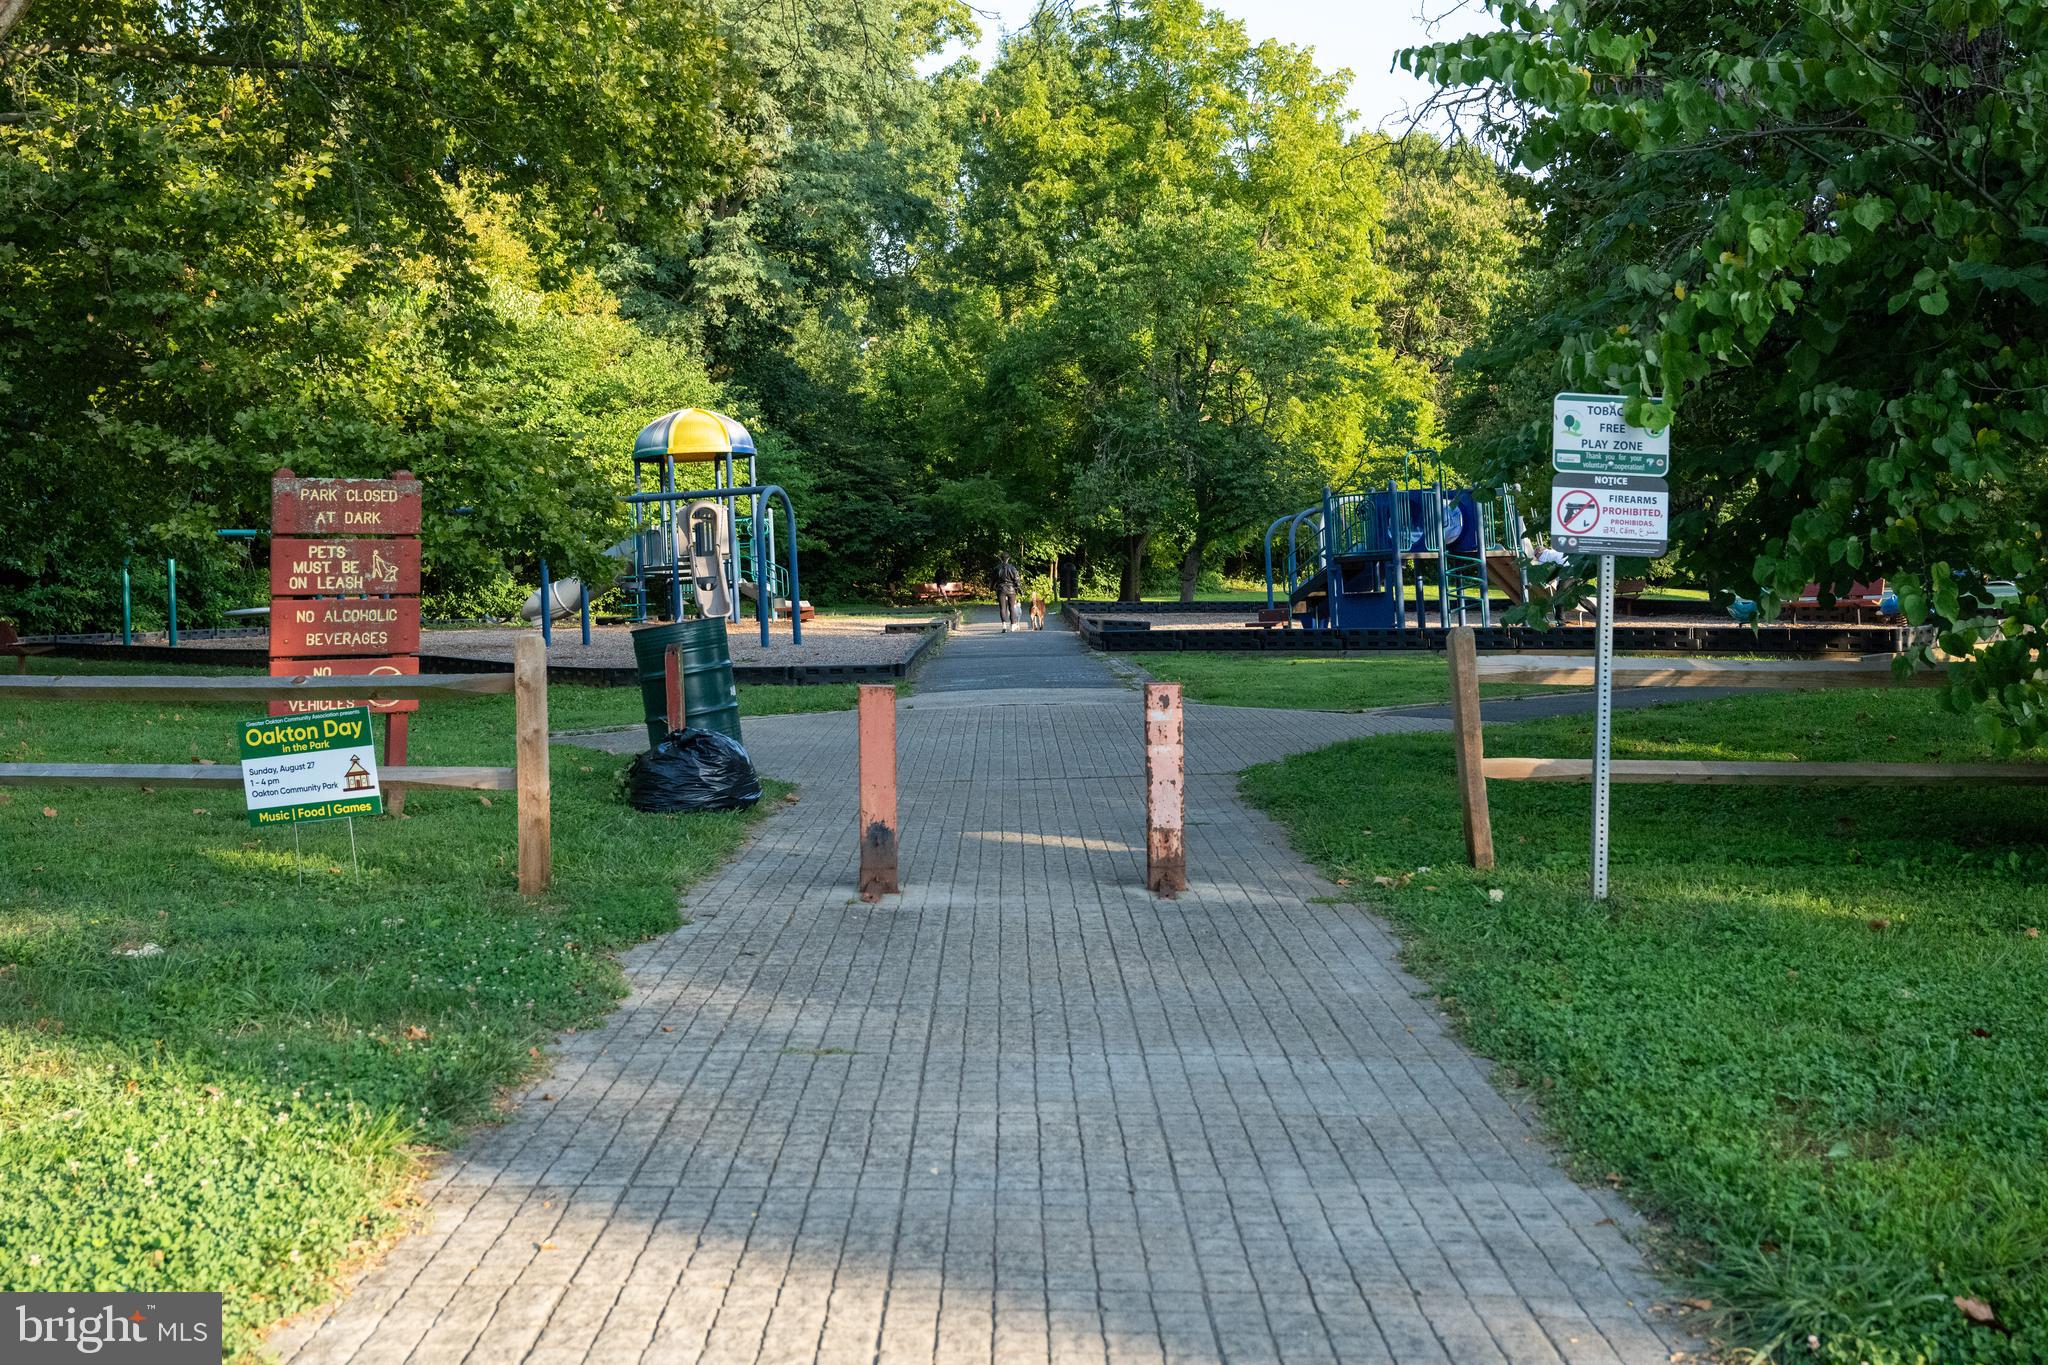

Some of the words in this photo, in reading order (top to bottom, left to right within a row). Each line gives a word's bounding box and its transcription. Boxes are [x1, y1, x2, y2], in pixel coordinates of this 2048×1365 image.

[1587, 405, 1624, 416] TOBAC
[1600, 423, 1625, 433] FREE
[1581, 439, 1608, 449] PLAY
[1613, 441, 1643, 450] ZONE
[1583, 462, 1608, 470] voluntary
[1595, 476, 1628, 485] NOTICE
[300, 489, 337, 501] PARK
[347, 490, 397, 502] CLOSED
[1609, 495, 1657, 504] FIREARMS
[316, 512, 336, 524] AT
[345, 512, 381, 524] DARK
[1603, 507, 1663, 518] PROHIBITED,
[309, 546, 346, 558] PETS
[294, 562, 332, 574] MUST
[342, 561, 359, 573] BE
[289, 577, 307, 589] ON
[318, 576, 363, 589] LEASH
[296, 611, 314, 623] NO
[324, 609, 397, 622] ALCOHOLIC
[306, 632, 387, 645] BEVERAGES
[313, 667, 332, 677] NO
[289, 700, 355, 711] VEHICLES
[246, 726, 318, 746] Oakton
[324, 720, 362, 738] Day
[292, 742, 307, 751] the
[310, 740, 330, 750] Park
[249, 766, 278, 776] Sunday,
[280, 763, 305, 773] August
[268, 778, 279, 786] pm
[252, 789, 279, 798] Oakton
[280, 784, 320, 795] Community
[259, 810, 290, 822] Music
[298, 807, 325, 818] Food
[334, 803, 372, 814] Games
